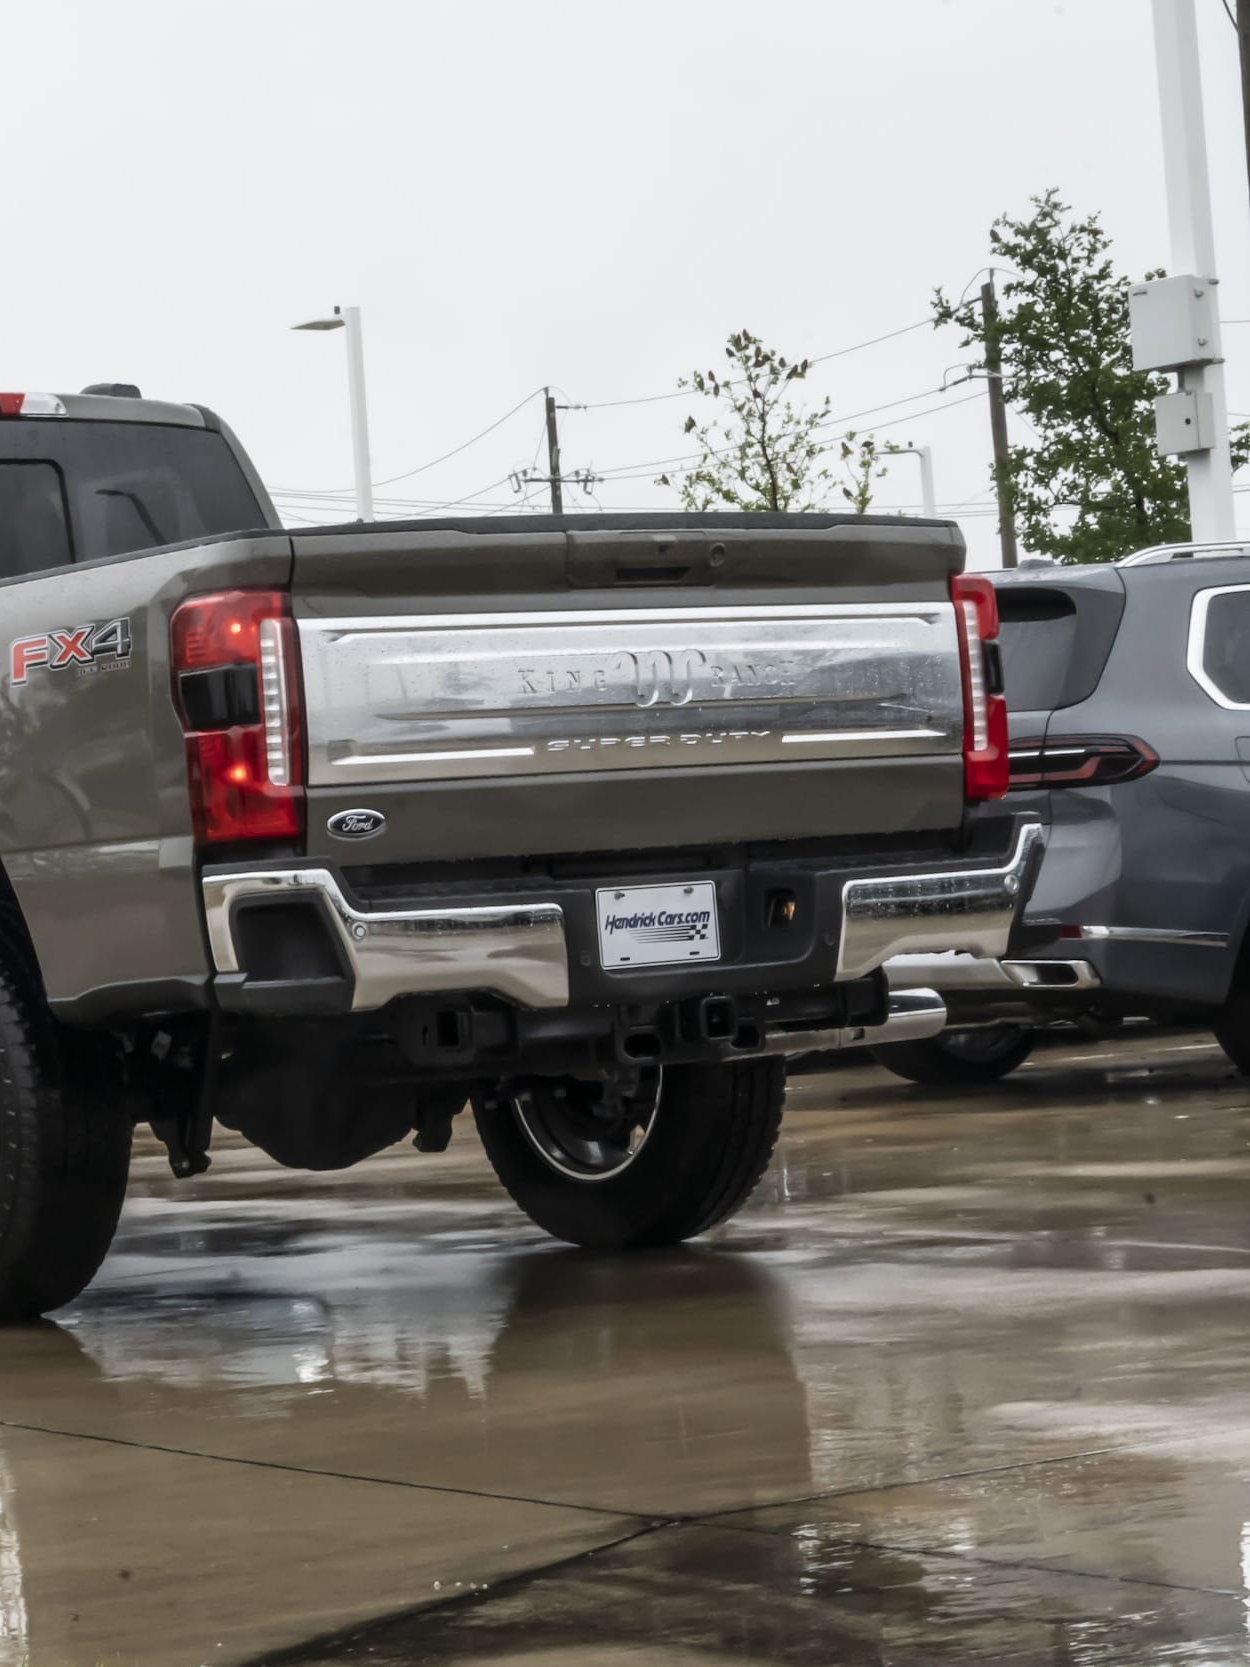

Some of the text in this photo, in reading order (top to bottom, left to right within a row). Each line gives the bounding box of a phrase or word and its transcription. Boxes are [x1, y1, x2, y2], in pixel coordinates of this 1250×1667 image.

[10, 617, 132, 688] FX4
[517, 667, 608, 694] KING
[342, 815, 374, 831] Ford
